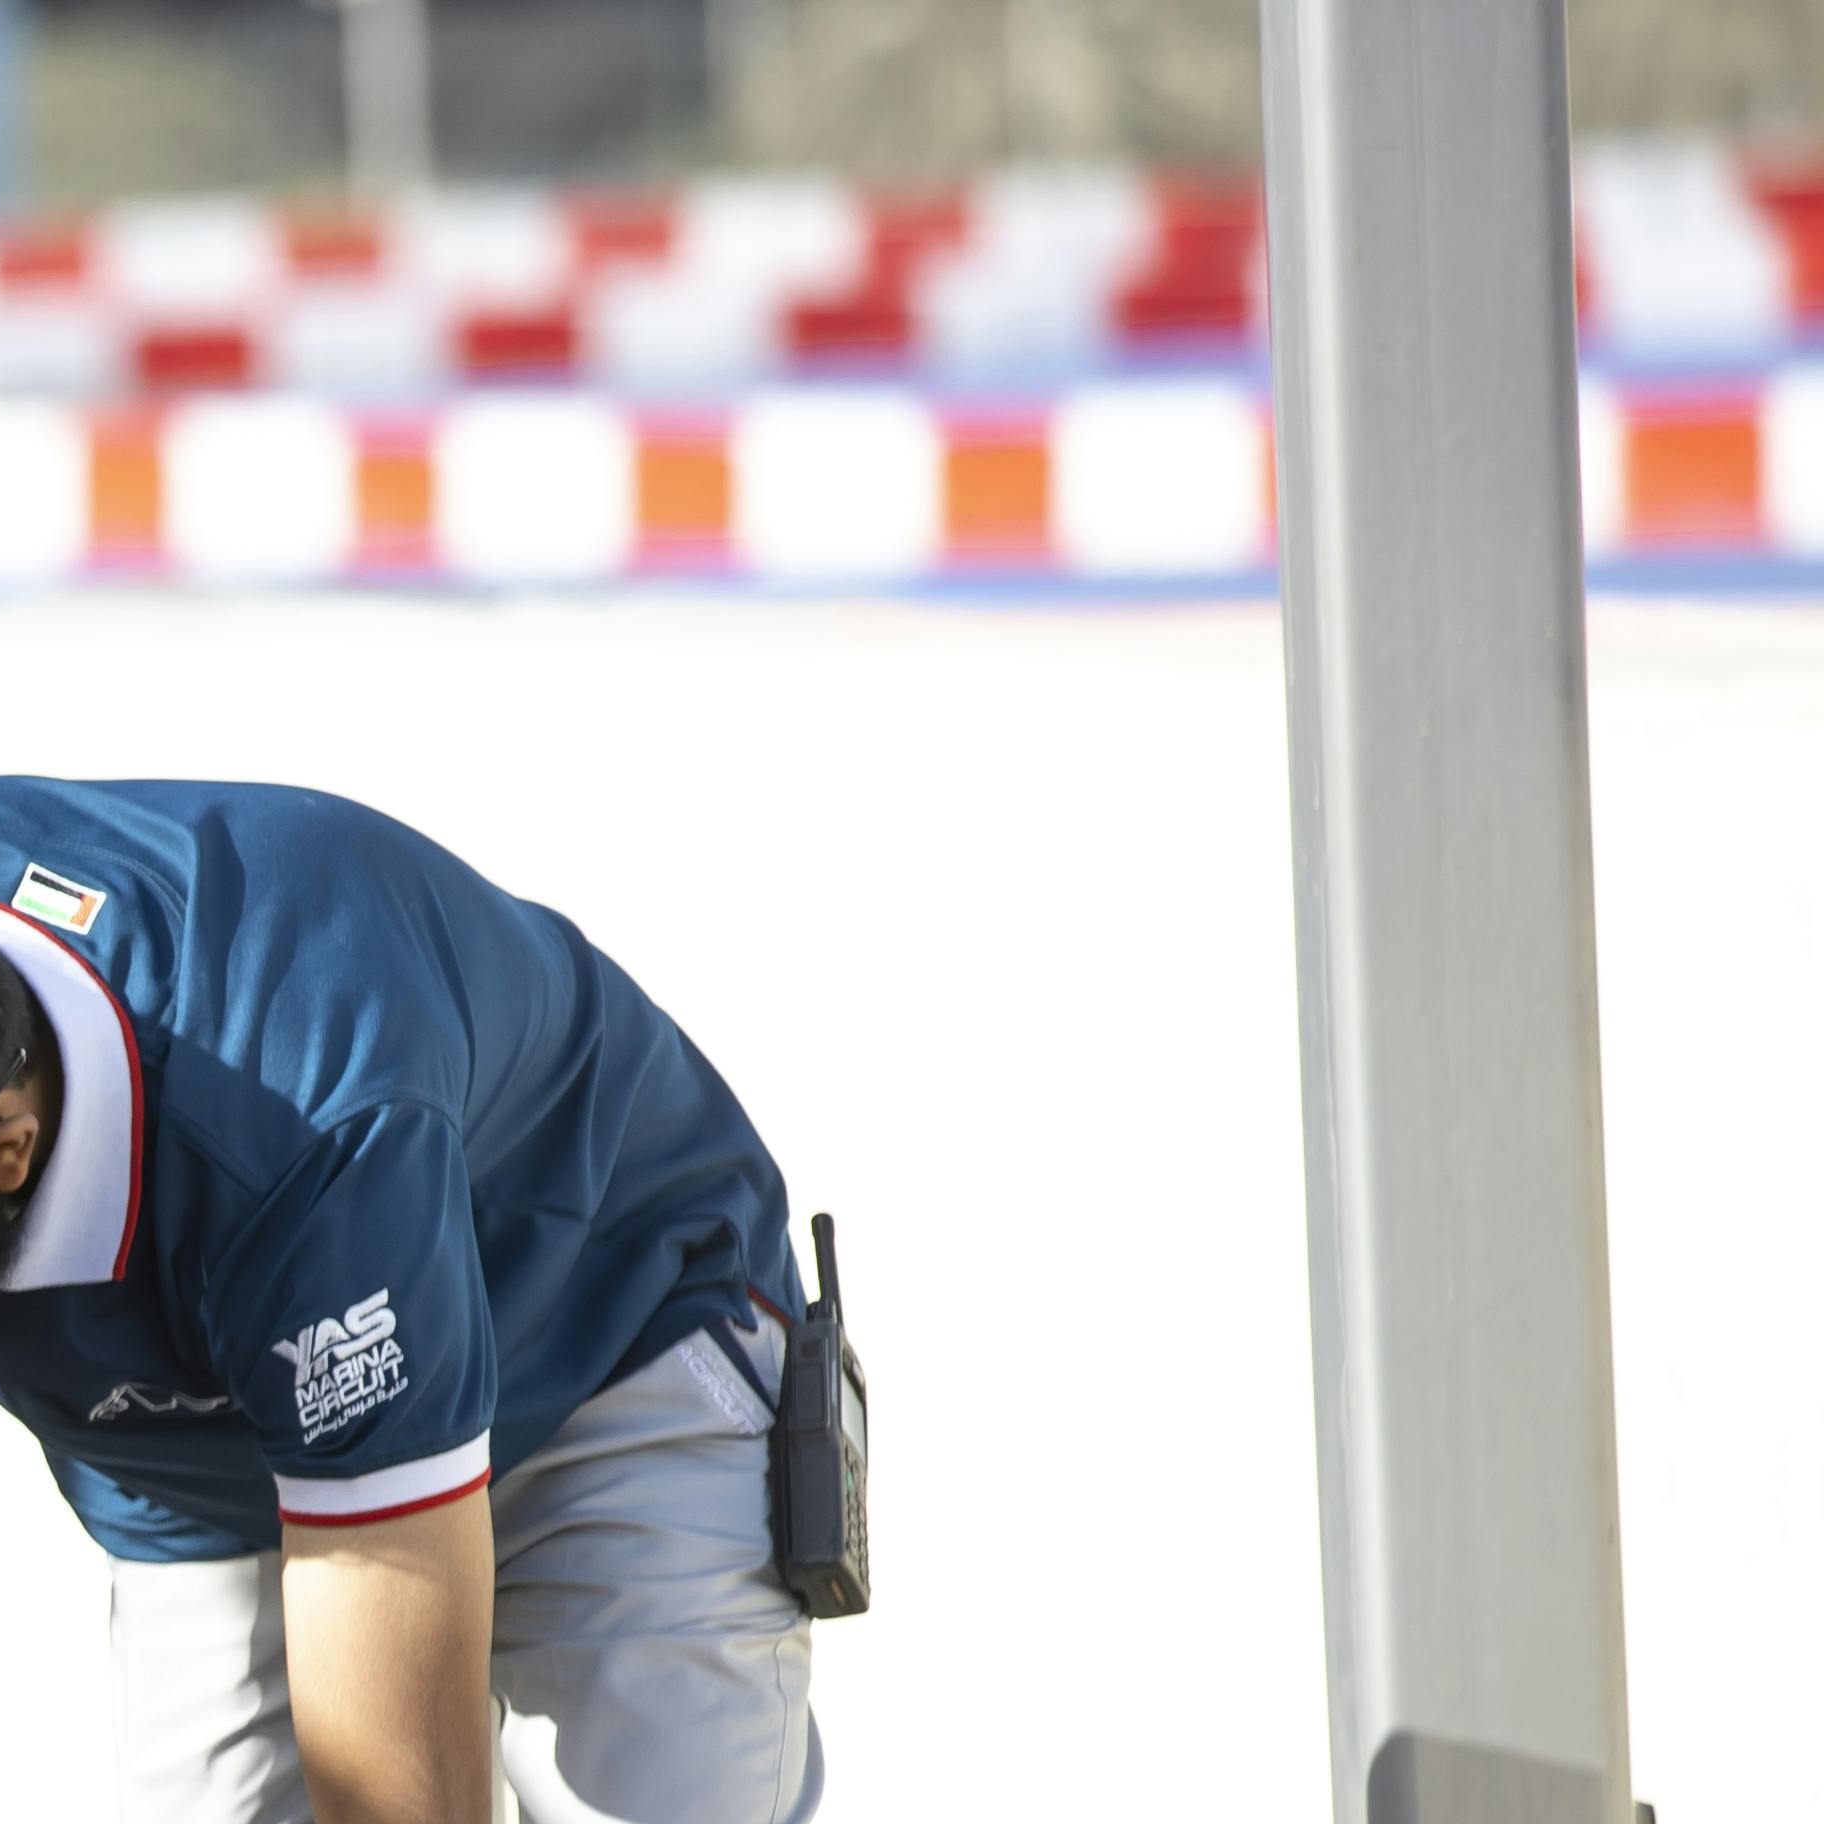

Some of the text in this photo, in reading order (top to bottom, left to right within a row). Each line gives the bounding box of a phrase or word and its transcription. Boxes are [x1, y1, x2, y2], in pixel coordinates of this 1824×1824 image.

[271, 1287, 397, 1386] YAS
[295, 1338, 403, 1409] MARINA
[298, 1353, 405, 1429] CIRCUIT
